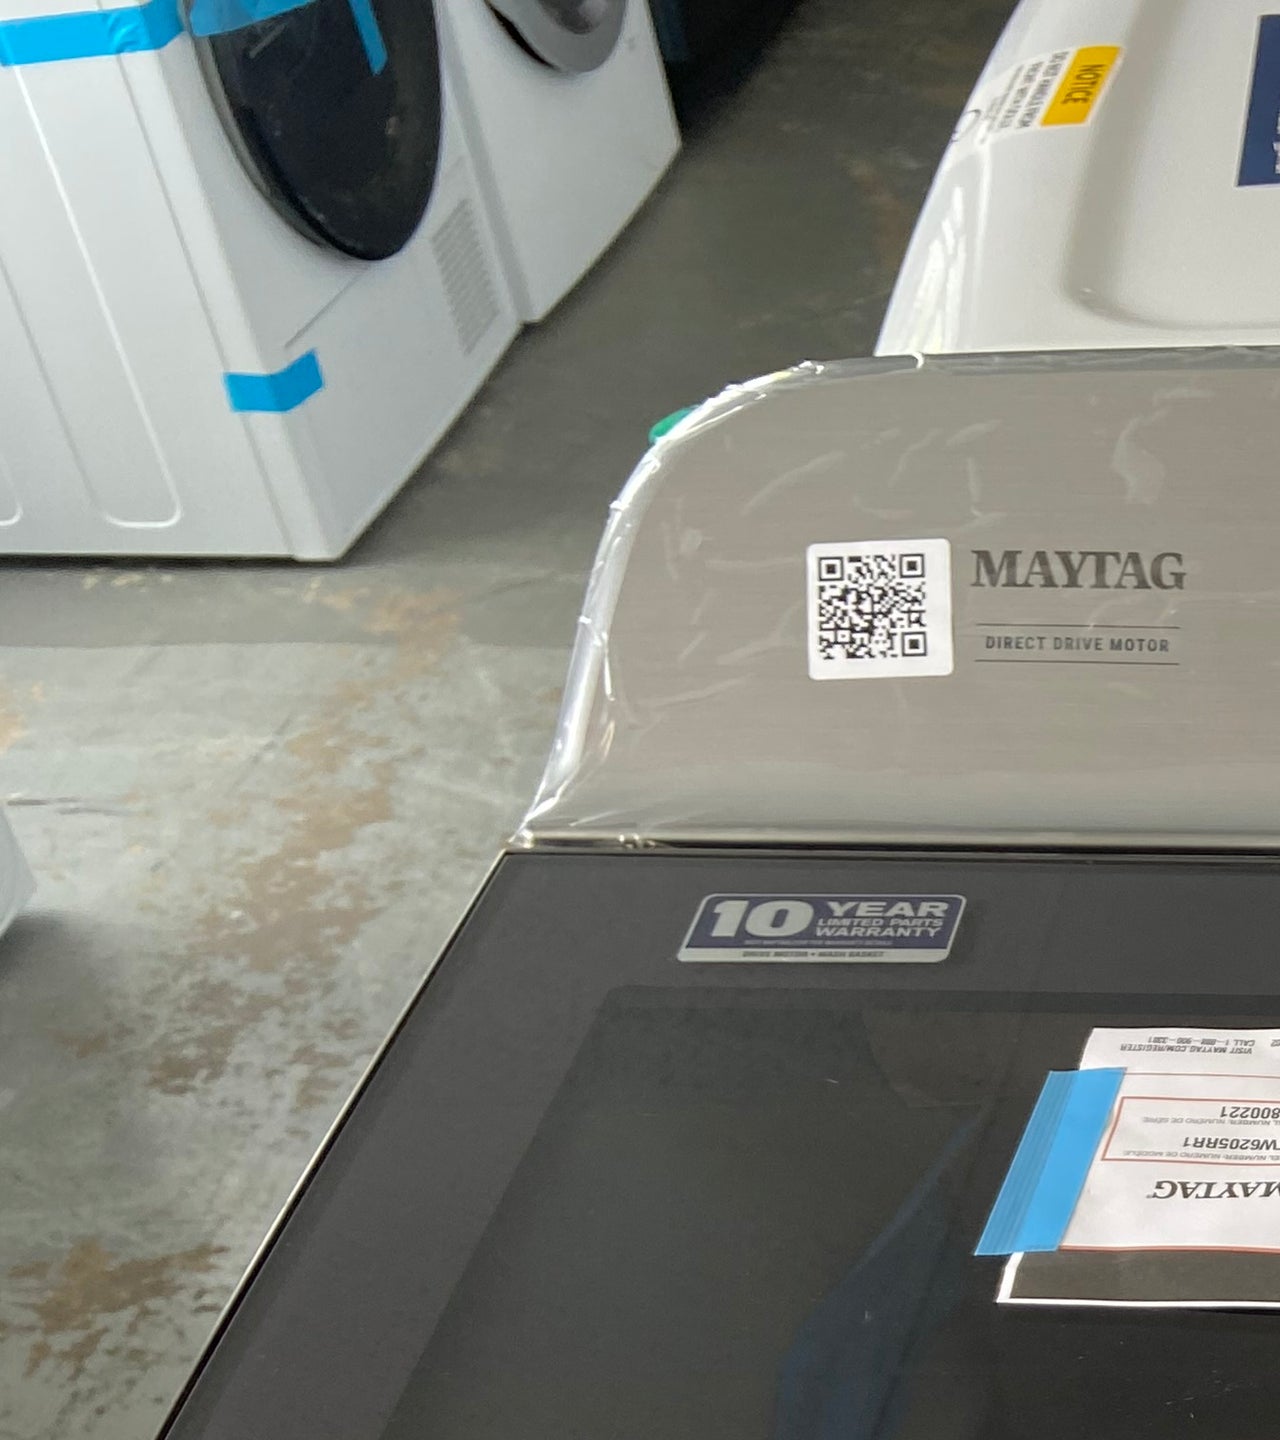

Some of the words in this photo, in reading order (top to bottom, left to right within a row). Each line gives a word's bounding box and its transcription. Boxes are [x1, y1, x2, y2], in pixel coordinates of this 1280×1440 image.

[1060, 63, 1106, 105] NOTICE
[971, 550, 1187, 590] MAYTAG
[985, 636, 1047, 650] DIRECT
[1053, 637, 1103, 651] DRIVE
[1110, 638, 1169, 652] MOTOR
[827, 901, 949, 917] YEAR
[711, 900, 813, 937] 10
[818, 918, 884, 926] LIMITED
[889, 918, 943, 926] PARTS
[816, 927, 941, 937] WARRANTY
